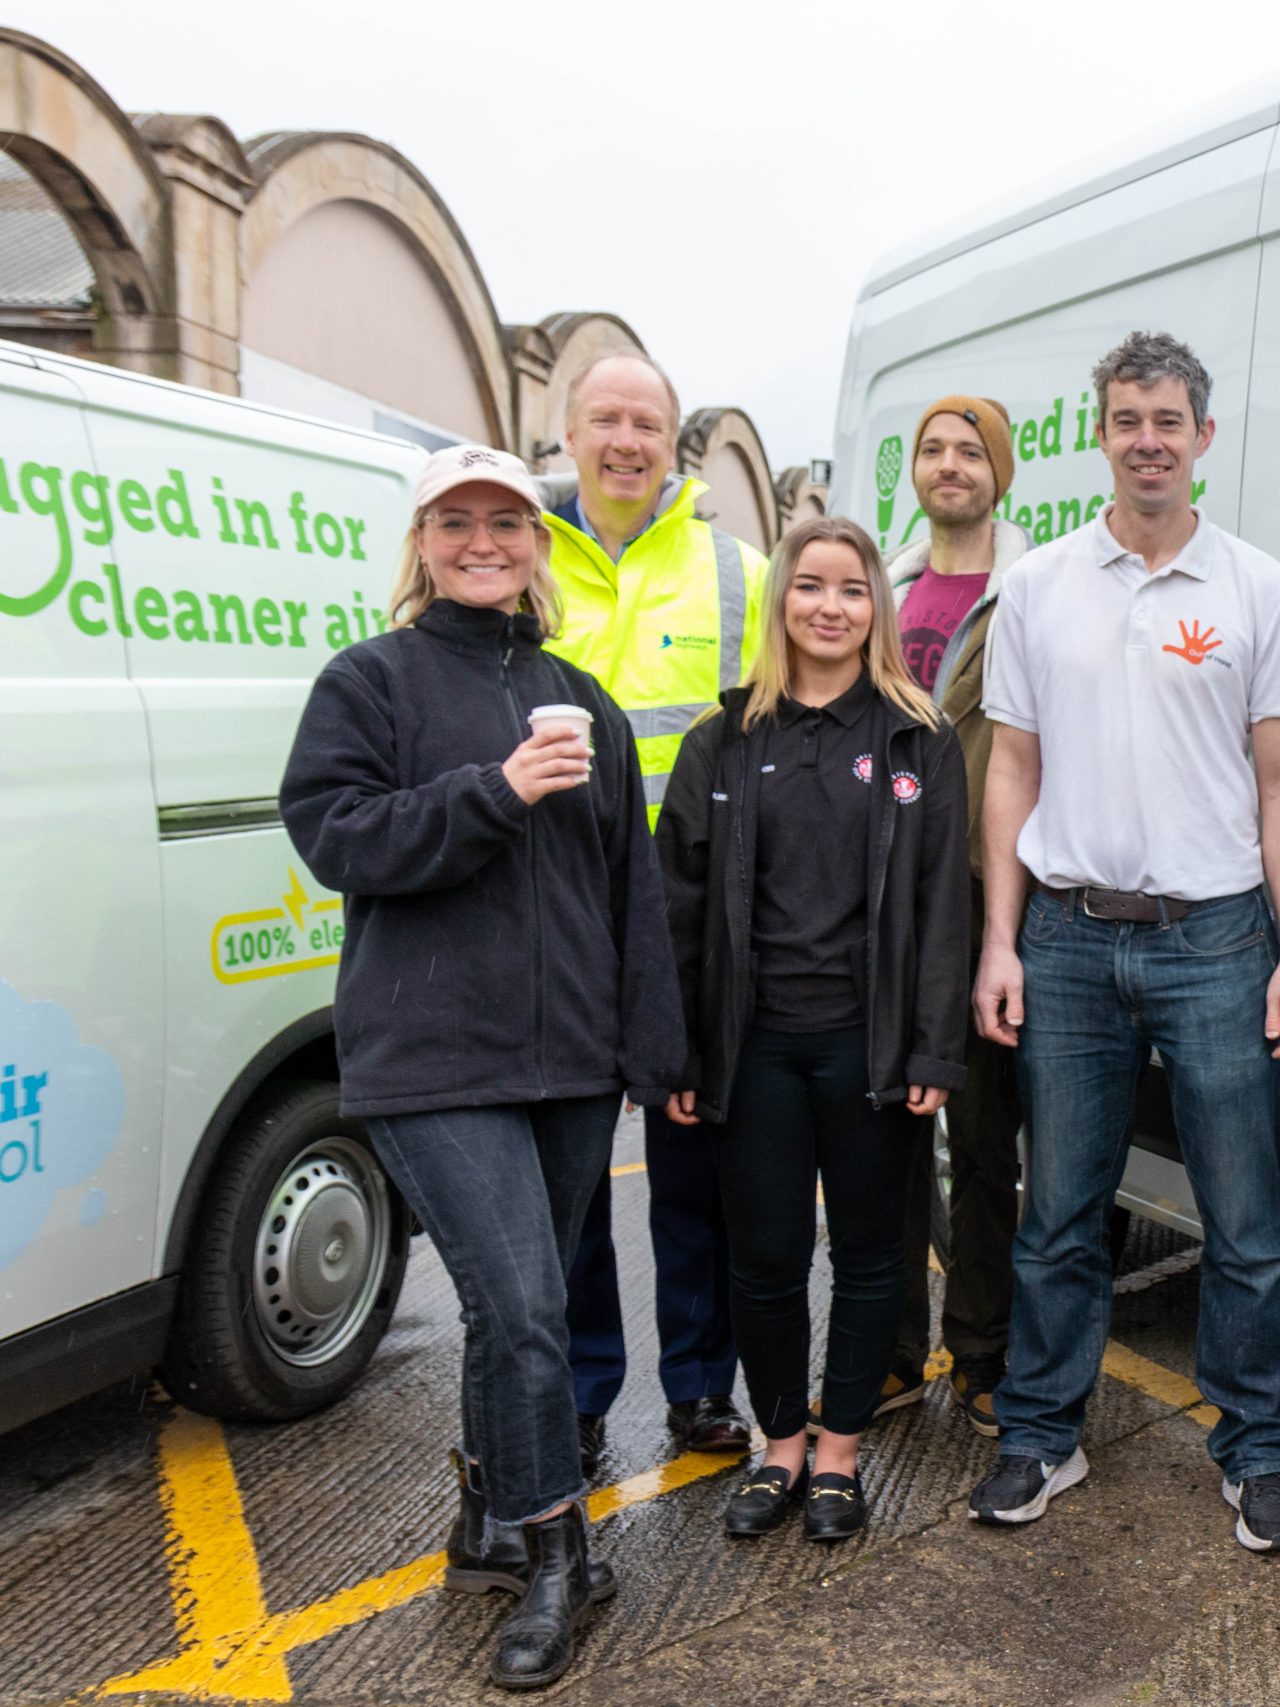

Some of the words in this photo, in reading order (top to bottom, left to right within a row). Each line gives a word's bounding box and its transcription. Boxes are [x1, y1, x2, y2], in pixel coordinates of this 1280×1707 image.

[211, 476, 279, 549] in
[289, 491, 366, 560] for
[68, 563, 308, 648] cleaner
[224, 925, 296, 967] 100%
